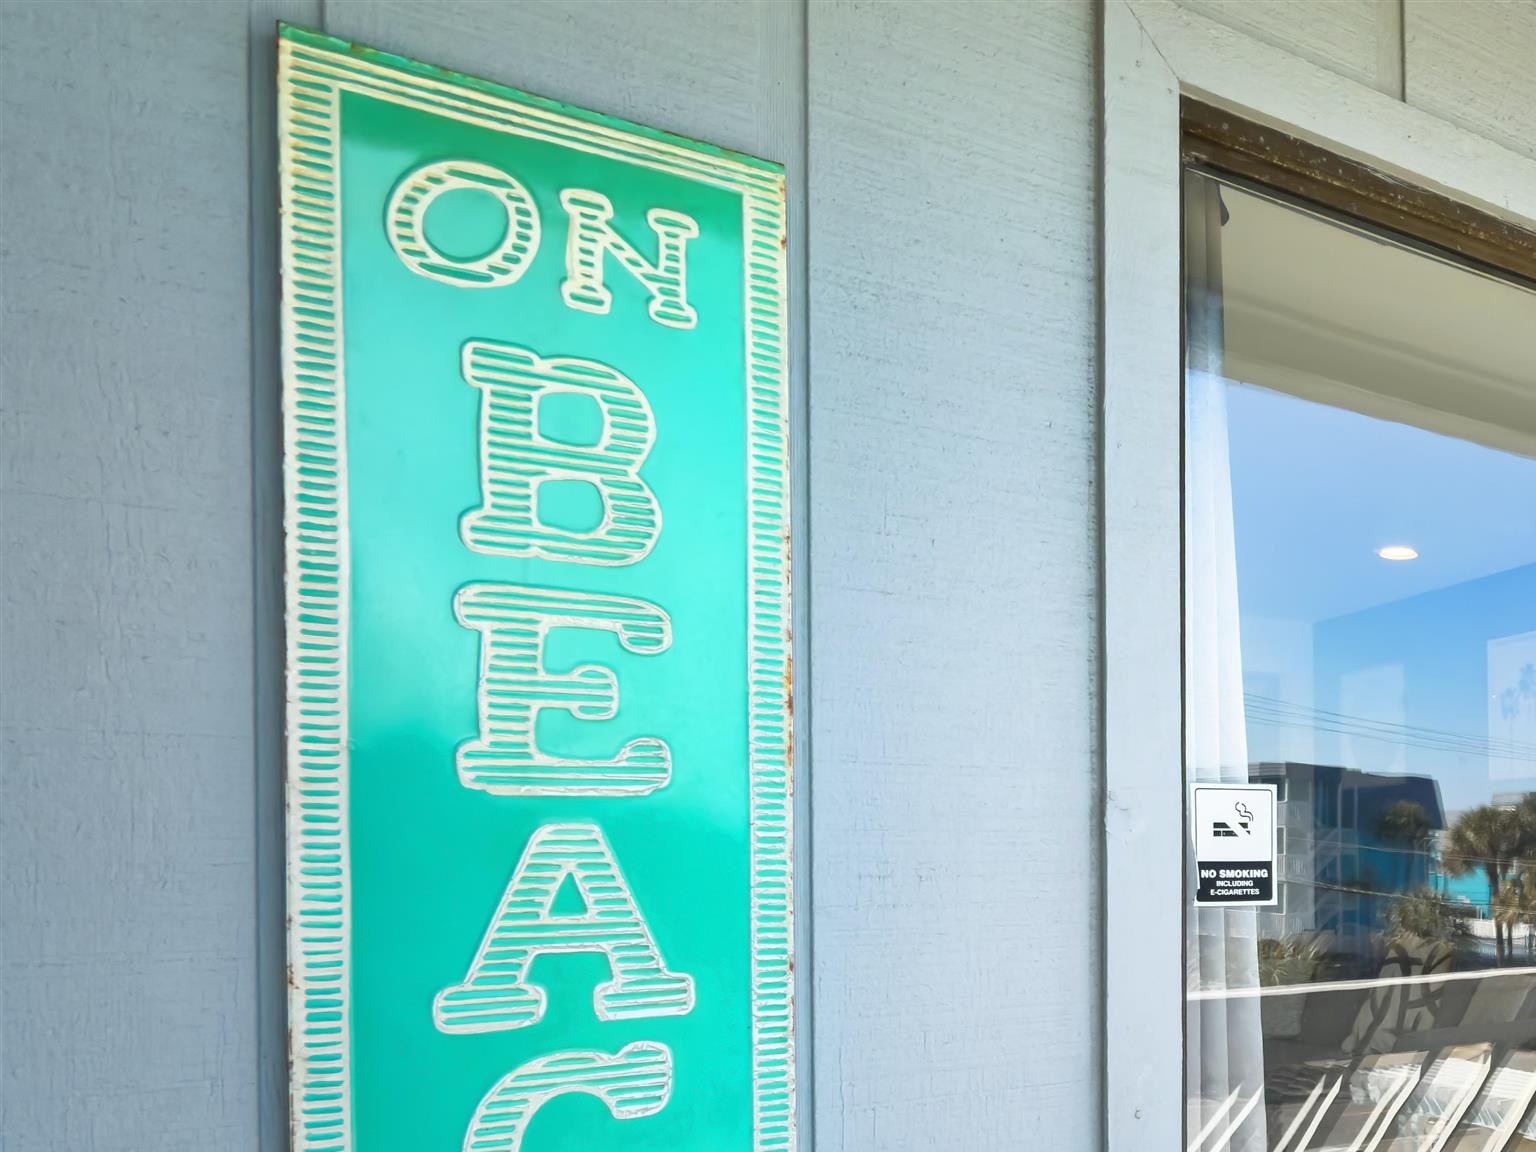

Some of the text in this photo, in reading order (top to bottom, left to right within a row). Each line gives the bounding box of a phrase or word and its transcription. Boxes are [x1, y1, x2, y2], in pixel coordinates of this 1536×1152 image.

[385, 159, 699, 329] ON
[1200, 869, 1269, 879] NO SMOKING
[1210, 888, 1260, 896] E-CIGARETTES
